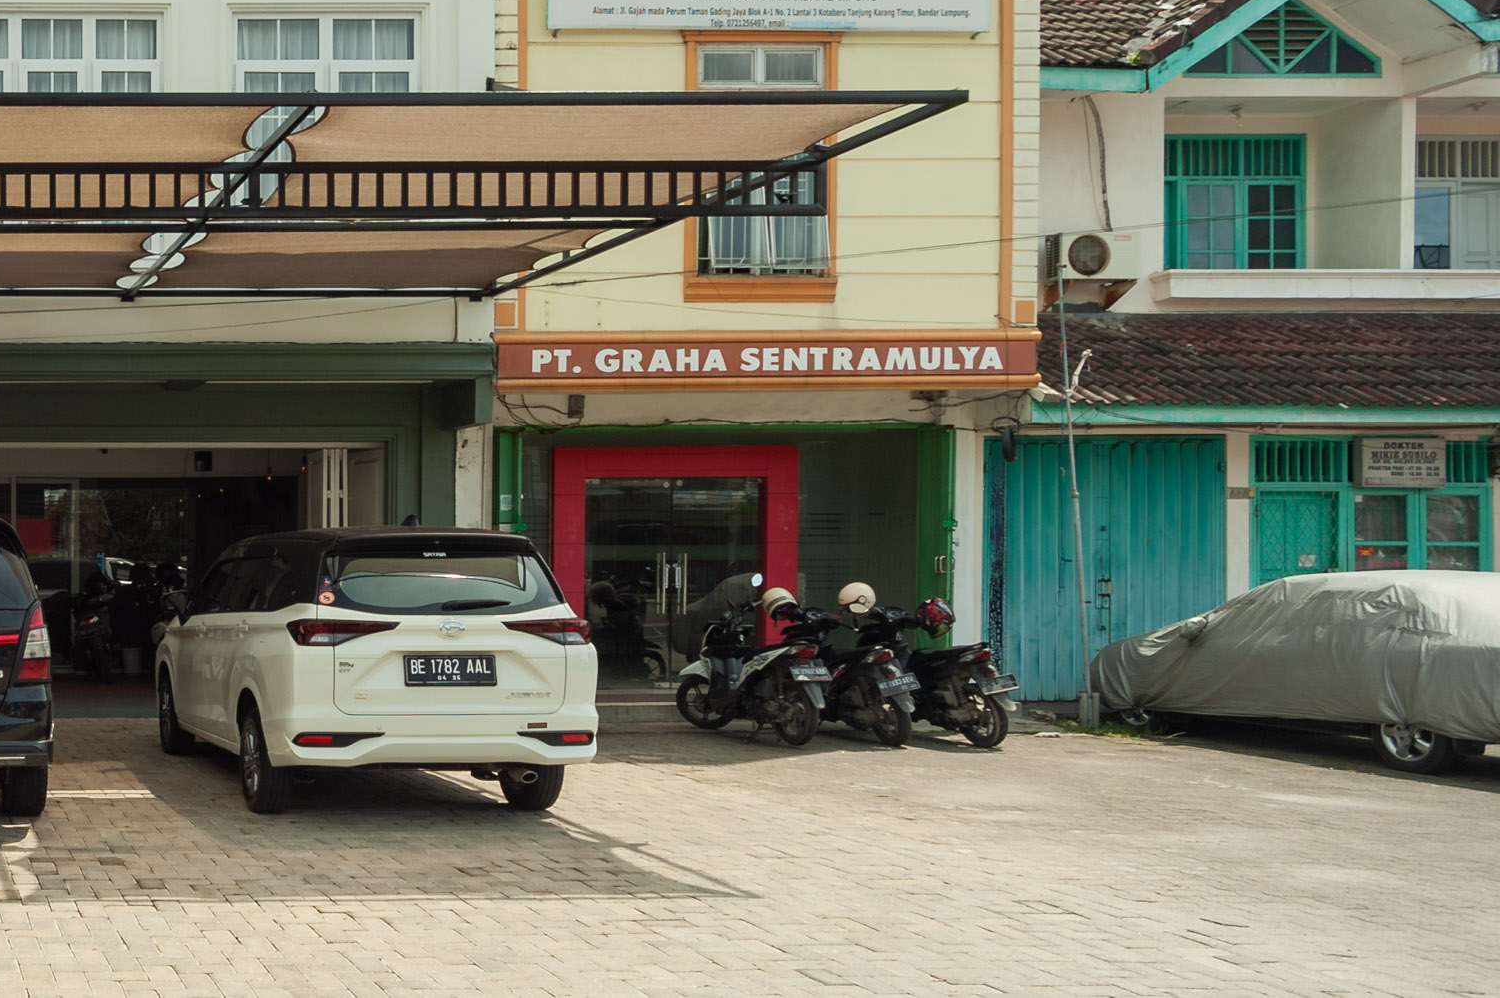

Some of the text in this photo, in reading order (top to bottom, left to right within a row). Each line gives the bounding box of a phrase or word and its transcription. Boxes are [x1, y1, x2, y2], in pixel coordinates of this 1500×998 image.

[531, 346, 1004, 373] PT. GRAHA SENTRAMULYA
[1383, 442, 1424, 450] DOKTER
[410, 659, 491, 674] BE 1782 AAL
